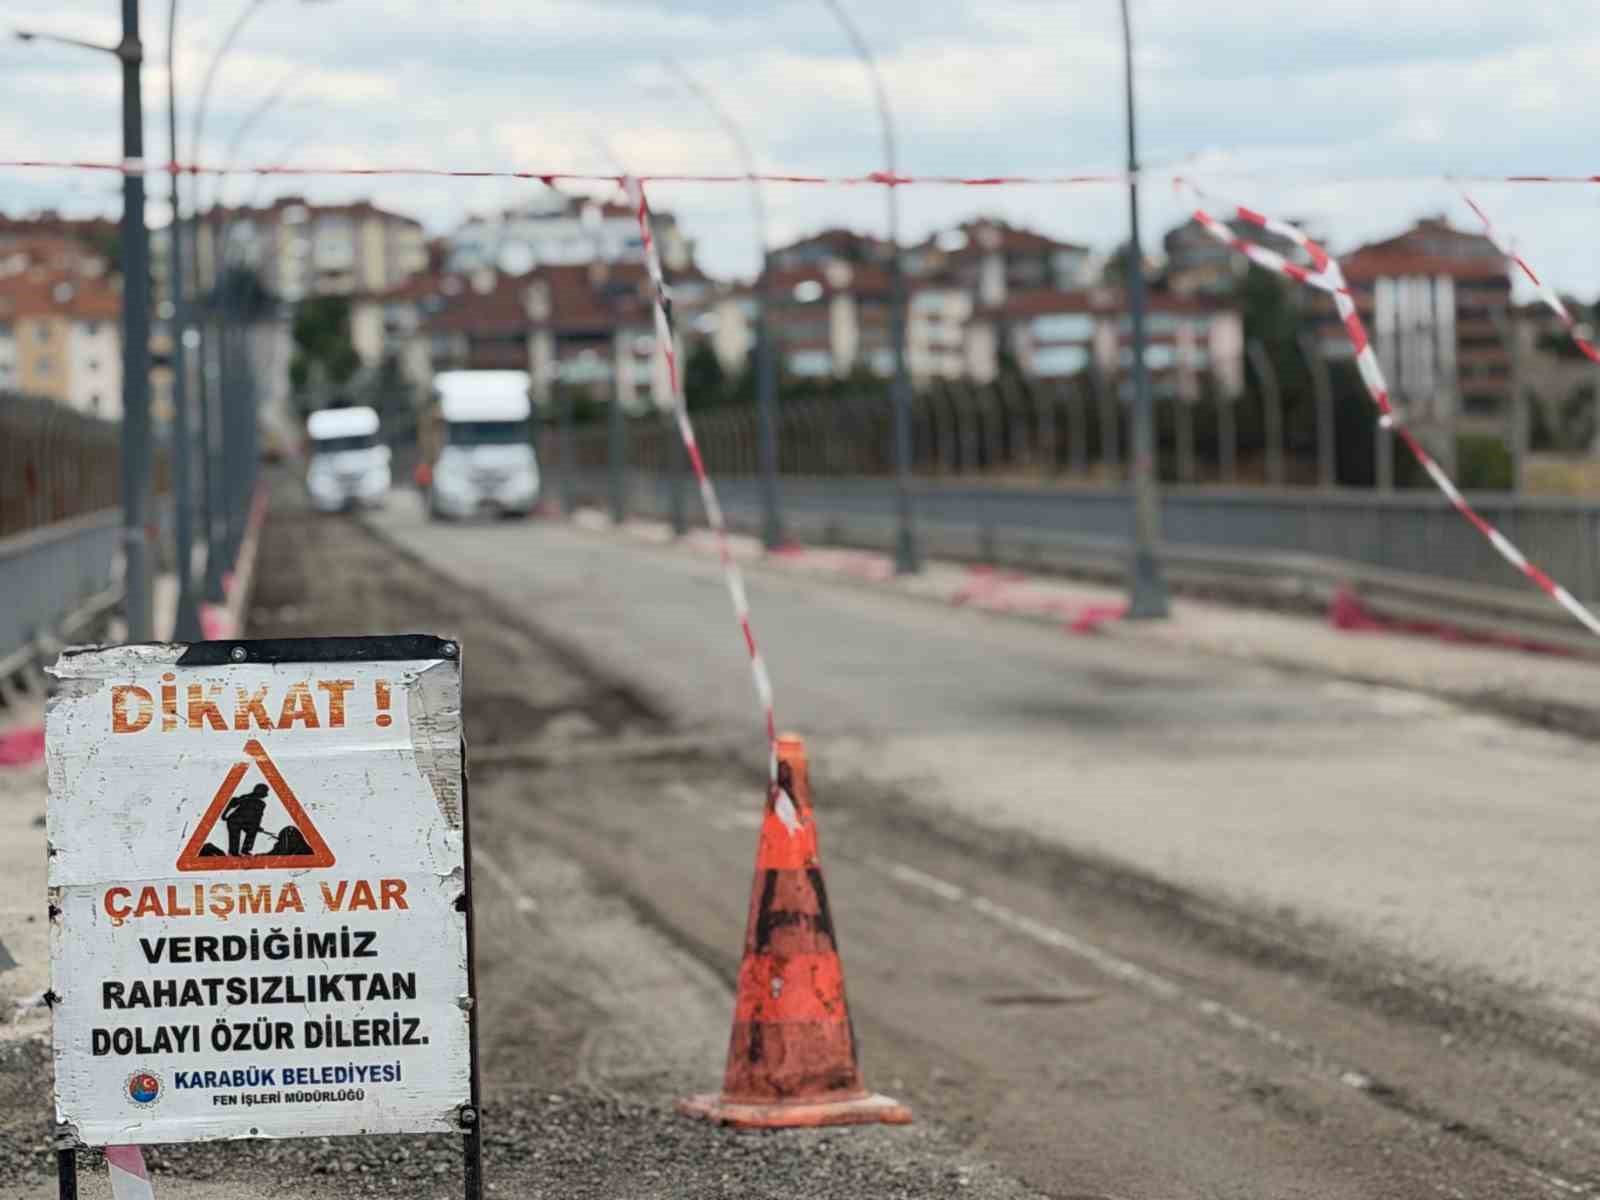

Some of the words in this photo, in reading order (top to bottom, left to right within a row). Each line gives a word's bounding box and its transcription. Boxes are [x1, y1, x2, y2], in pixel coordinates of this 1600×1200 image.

[111, 672, 355, 733] DİKKAT
[104, 881, 304, 927] ÇALIŞMA
[319, 878, 409, 912] VAR
[139, 925, 378, 964] VERDİĞİMİZ
[102, 972, 417, 1010] RAHATSIZLIKTAN
[92, 1023, 200, 1057] DOLAYI
[210, 1017, 294, 1051] ÖZÜR
[304, 1011, 430, 1048] DİLERİZ.
[174, 1066, 275, 1089] KARABÜK
[282, 1060, 401, 1085] BELEDİYESİ
[213, 1094, 237, 1106] FEN
[241, 1091, 281, 1107] İŞLERİ
[285, 1088, 365, 1103] MÜDÜRLÜĞÜ
